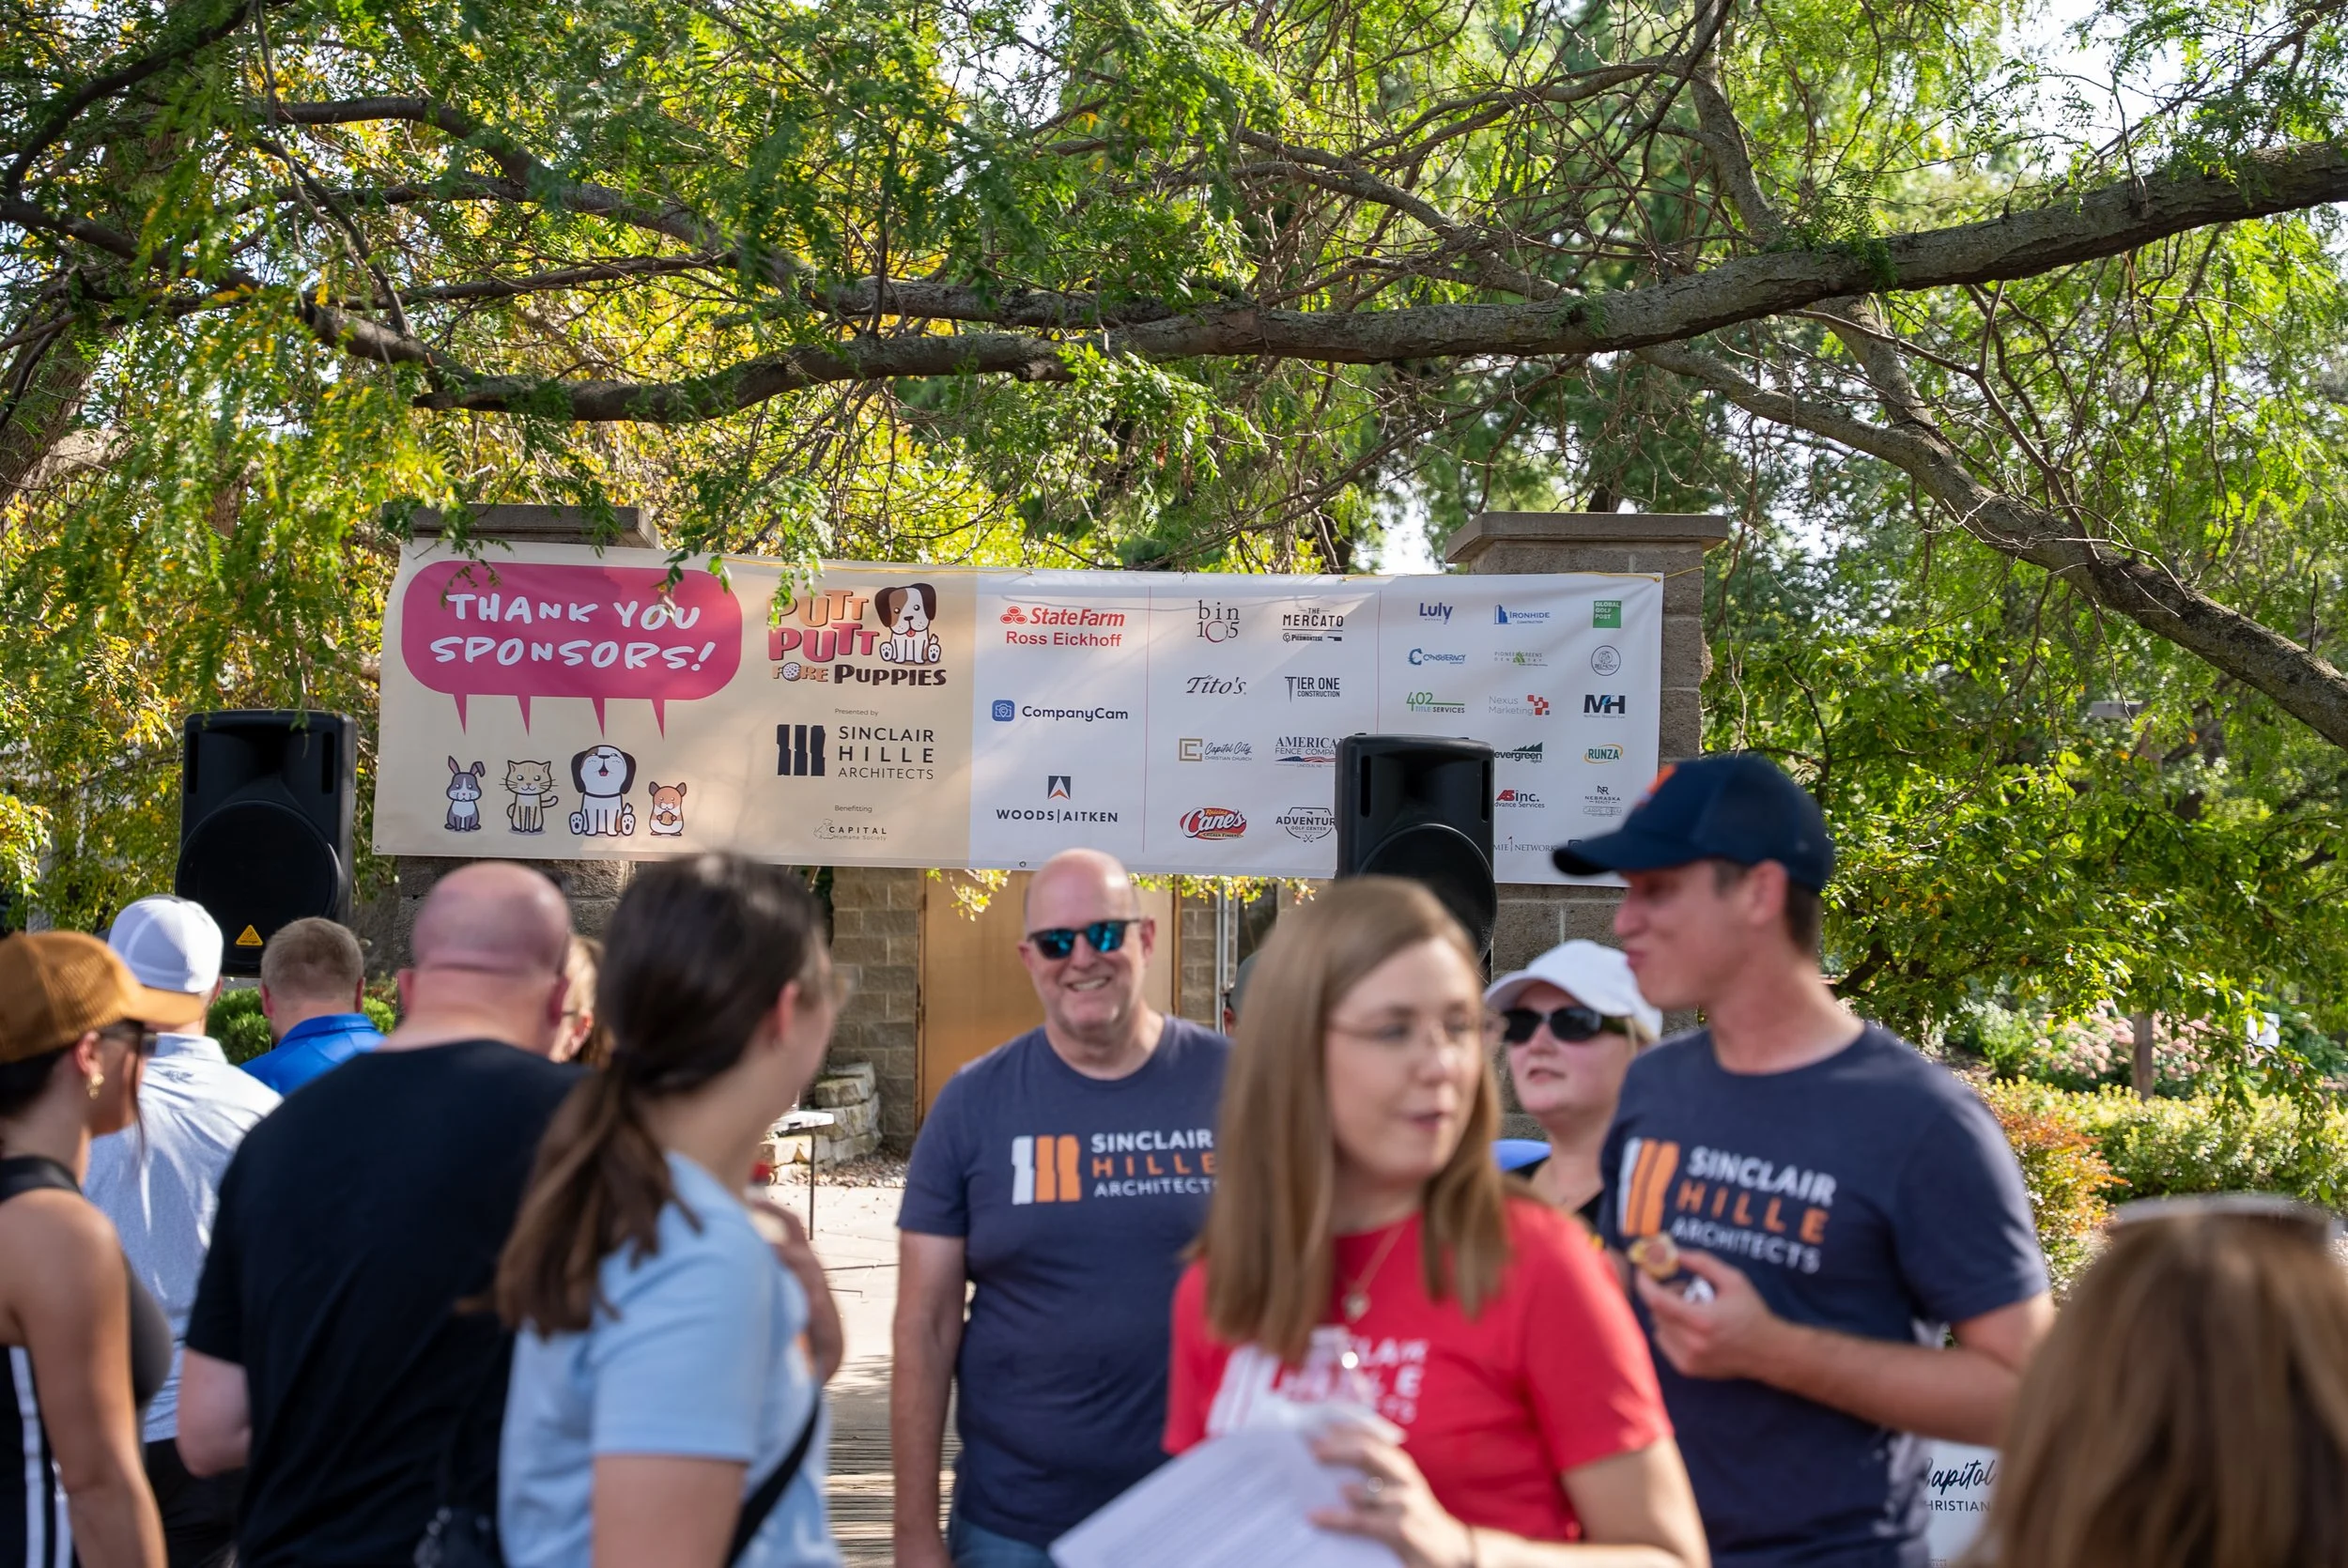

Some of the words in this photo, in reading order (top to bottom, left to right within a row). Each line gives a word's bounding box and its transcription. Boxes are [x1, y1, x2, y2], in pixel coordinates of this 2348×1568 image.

[446, 593, 598, 623] THANK
[613, 600, 701, 630] YOU
[767, 590, 870, 628] PUTT
[1197, 599, 1240, 621] bin
[1419, 602, 1453, 624] Luly
[1282, 614, 1344, 627] MERCATO
[768, 623, 880, 663] PUTT
[1006, 631, 1048, 645] Ross
[1053, 632, 1122, 647] Eickhoff
[429, 636, 716, 671] SPONSORS!
[834, 664, 947, 686] PUPPIES
[1186, 674, 1247, 695] Tito's
[1285, 676, 1315, 703] TIER
[1319, 677, 1340, 690] ONE
[1406, 692, 1433, 712] 402
[1489, 696, 1519, 704] Nexus
[1022, 705, 1129, 722] CompanyCam
[1488, 706, 1534, 716] Marketing
[839, 726, 935, 743] SINCLAIR
[839, 746, 935, 763] HILLE
[1234, 741, 1253, 755] City
[1274, 746, 1303, 755] FENCE
[1493, 751, 1542, 761] evergreen
[1587, 748, 1620, 760] RUNZA
[838, 767, 935, 780] ARCHITECTS
[834, 805, 873, 814] Benefitting
[828, 826, 888, 835] CAPITAL
[1182, 807, 1247, 838] Cane's
[1275, 816, 1335, 826] ADVENTUR
[1090, 1129, 1214, 1153] SINCLAIR
[1092, 1152, 1215, 1178] HILLE
[1687, 1145, 1837, 1207] SINCLAIR
[1093, 1177, 1219, 1198] ARCHITECT
[1676, 1179, 1830, 1244] HILLE
[1670, 1216, 1822, 1273] ARCHITECTS
[1923, 1499, 1991, 1513] HRISTIAN
